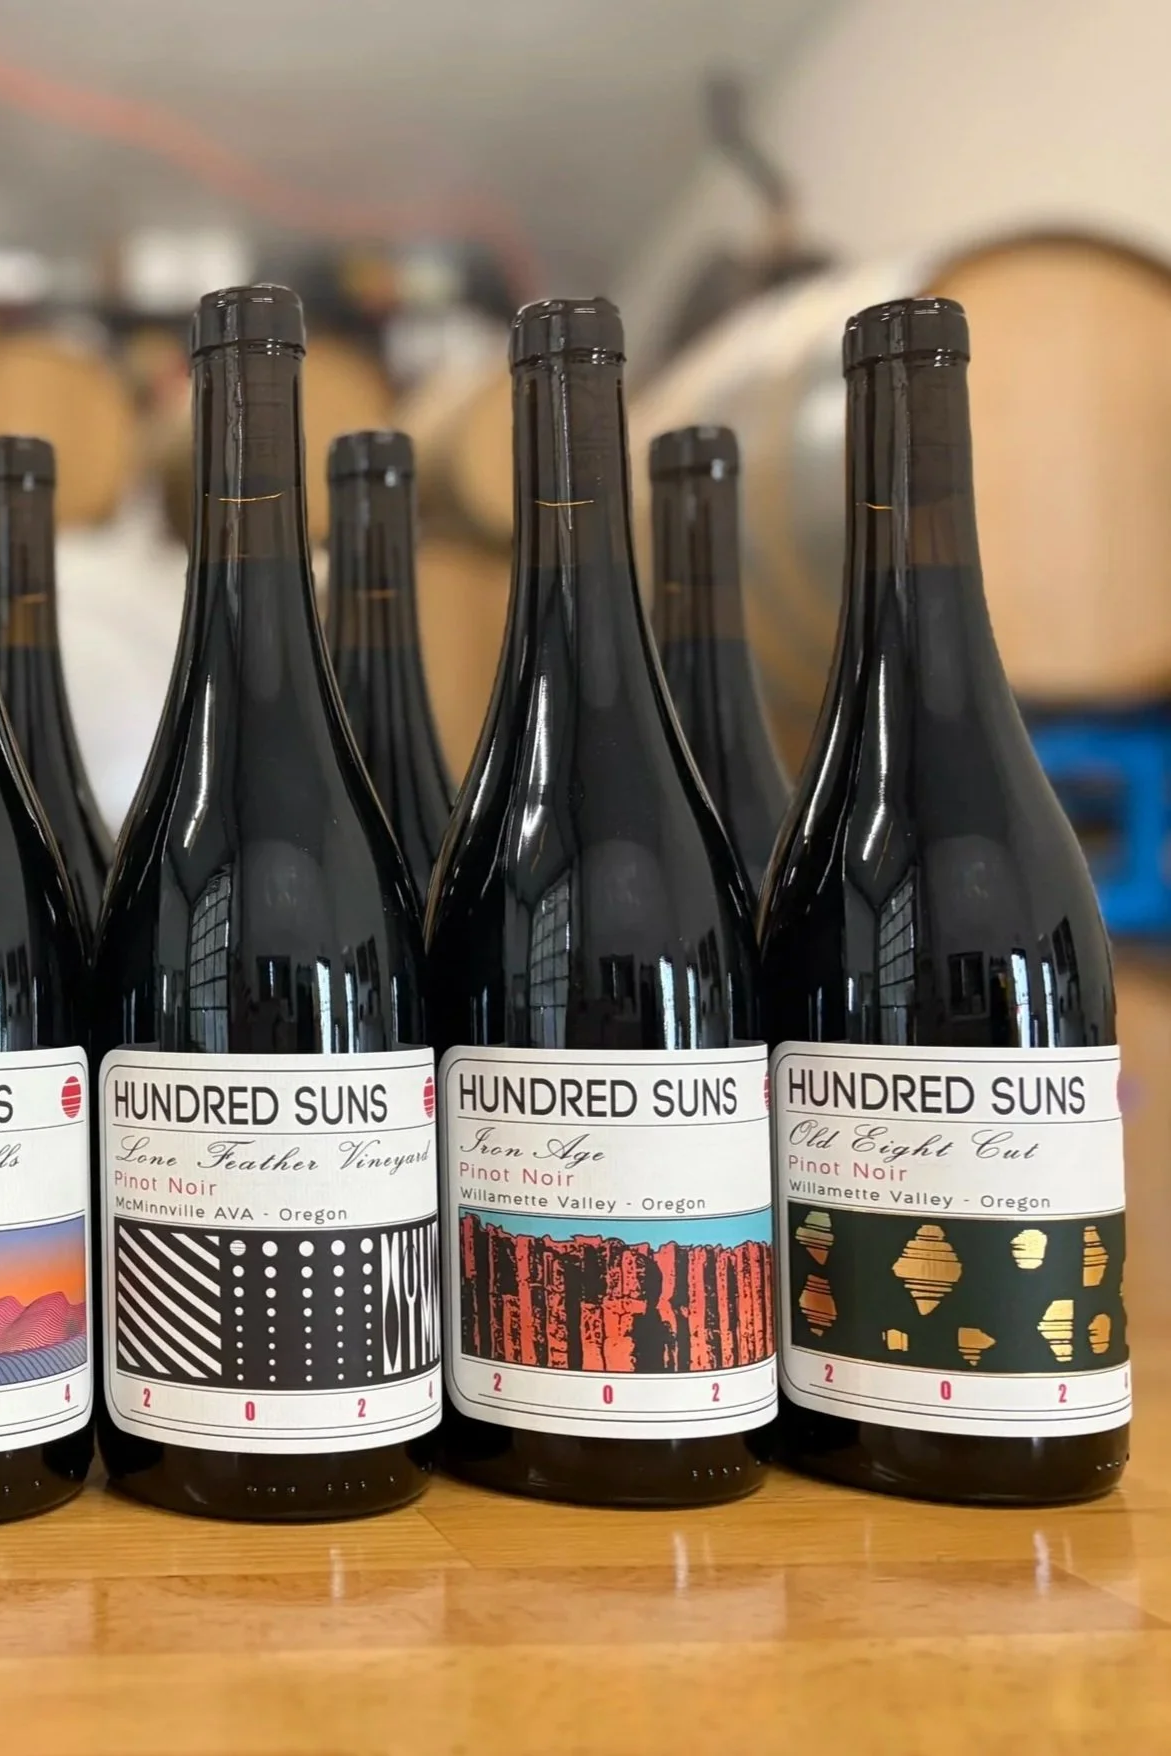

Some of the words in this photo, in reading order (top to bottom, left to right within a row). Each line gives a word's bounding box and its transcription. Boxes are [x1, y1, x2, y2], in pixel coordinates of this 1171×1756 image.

[114, 1080, 279, 1126] HUNDRED
[294, 1084, 387, 1126] SUNS
[459, 1073, 638, 1119] HUNDRED
[652, 1077, 737, 1118] SUNS
[788, 1067, 975, 1114] HUNDRED
[990, 1075, 1086, 1115] SUNS
[115, 1135, 178, 1168] Lone
[196, 1140, 319, 1172] Feather
[338, 1139, 432, 1175] Vineyard
[460, 1126, 524, 1158] Iron
[533, 1133, 608, 1170] Age
[788, 1119, 841, 1150] Old
[850, 1123, 955, 1163] Eight
[970, 1129, 1041, 1160] Cut
[114, 1170, 158, 1192] Pinot
[168, 1176, 218, 1197] Noir
[459, 1161, 510, 1184] Pinot
[522, 1167, 575, 1188] Noir
[788, 1154, 841, 1177] Pinot
[853, 1161, 908, 1182] Noir
[115, 1197, 206, 1219] McMinnville
[214, 1207, 254, 1221] AVA
[279, 1207, 348, 1225] Oregon
[460, 1186, 549, 1208] Willamette
[557, 1195, 617, 1213] Valley
[642, 1197, 706, 1214] Oregon
[789, 1179, 880, 1203] Willamette
[890, 1190, 953, 1210] Valley
[980, 1194, 1050, 1212] Oregon
